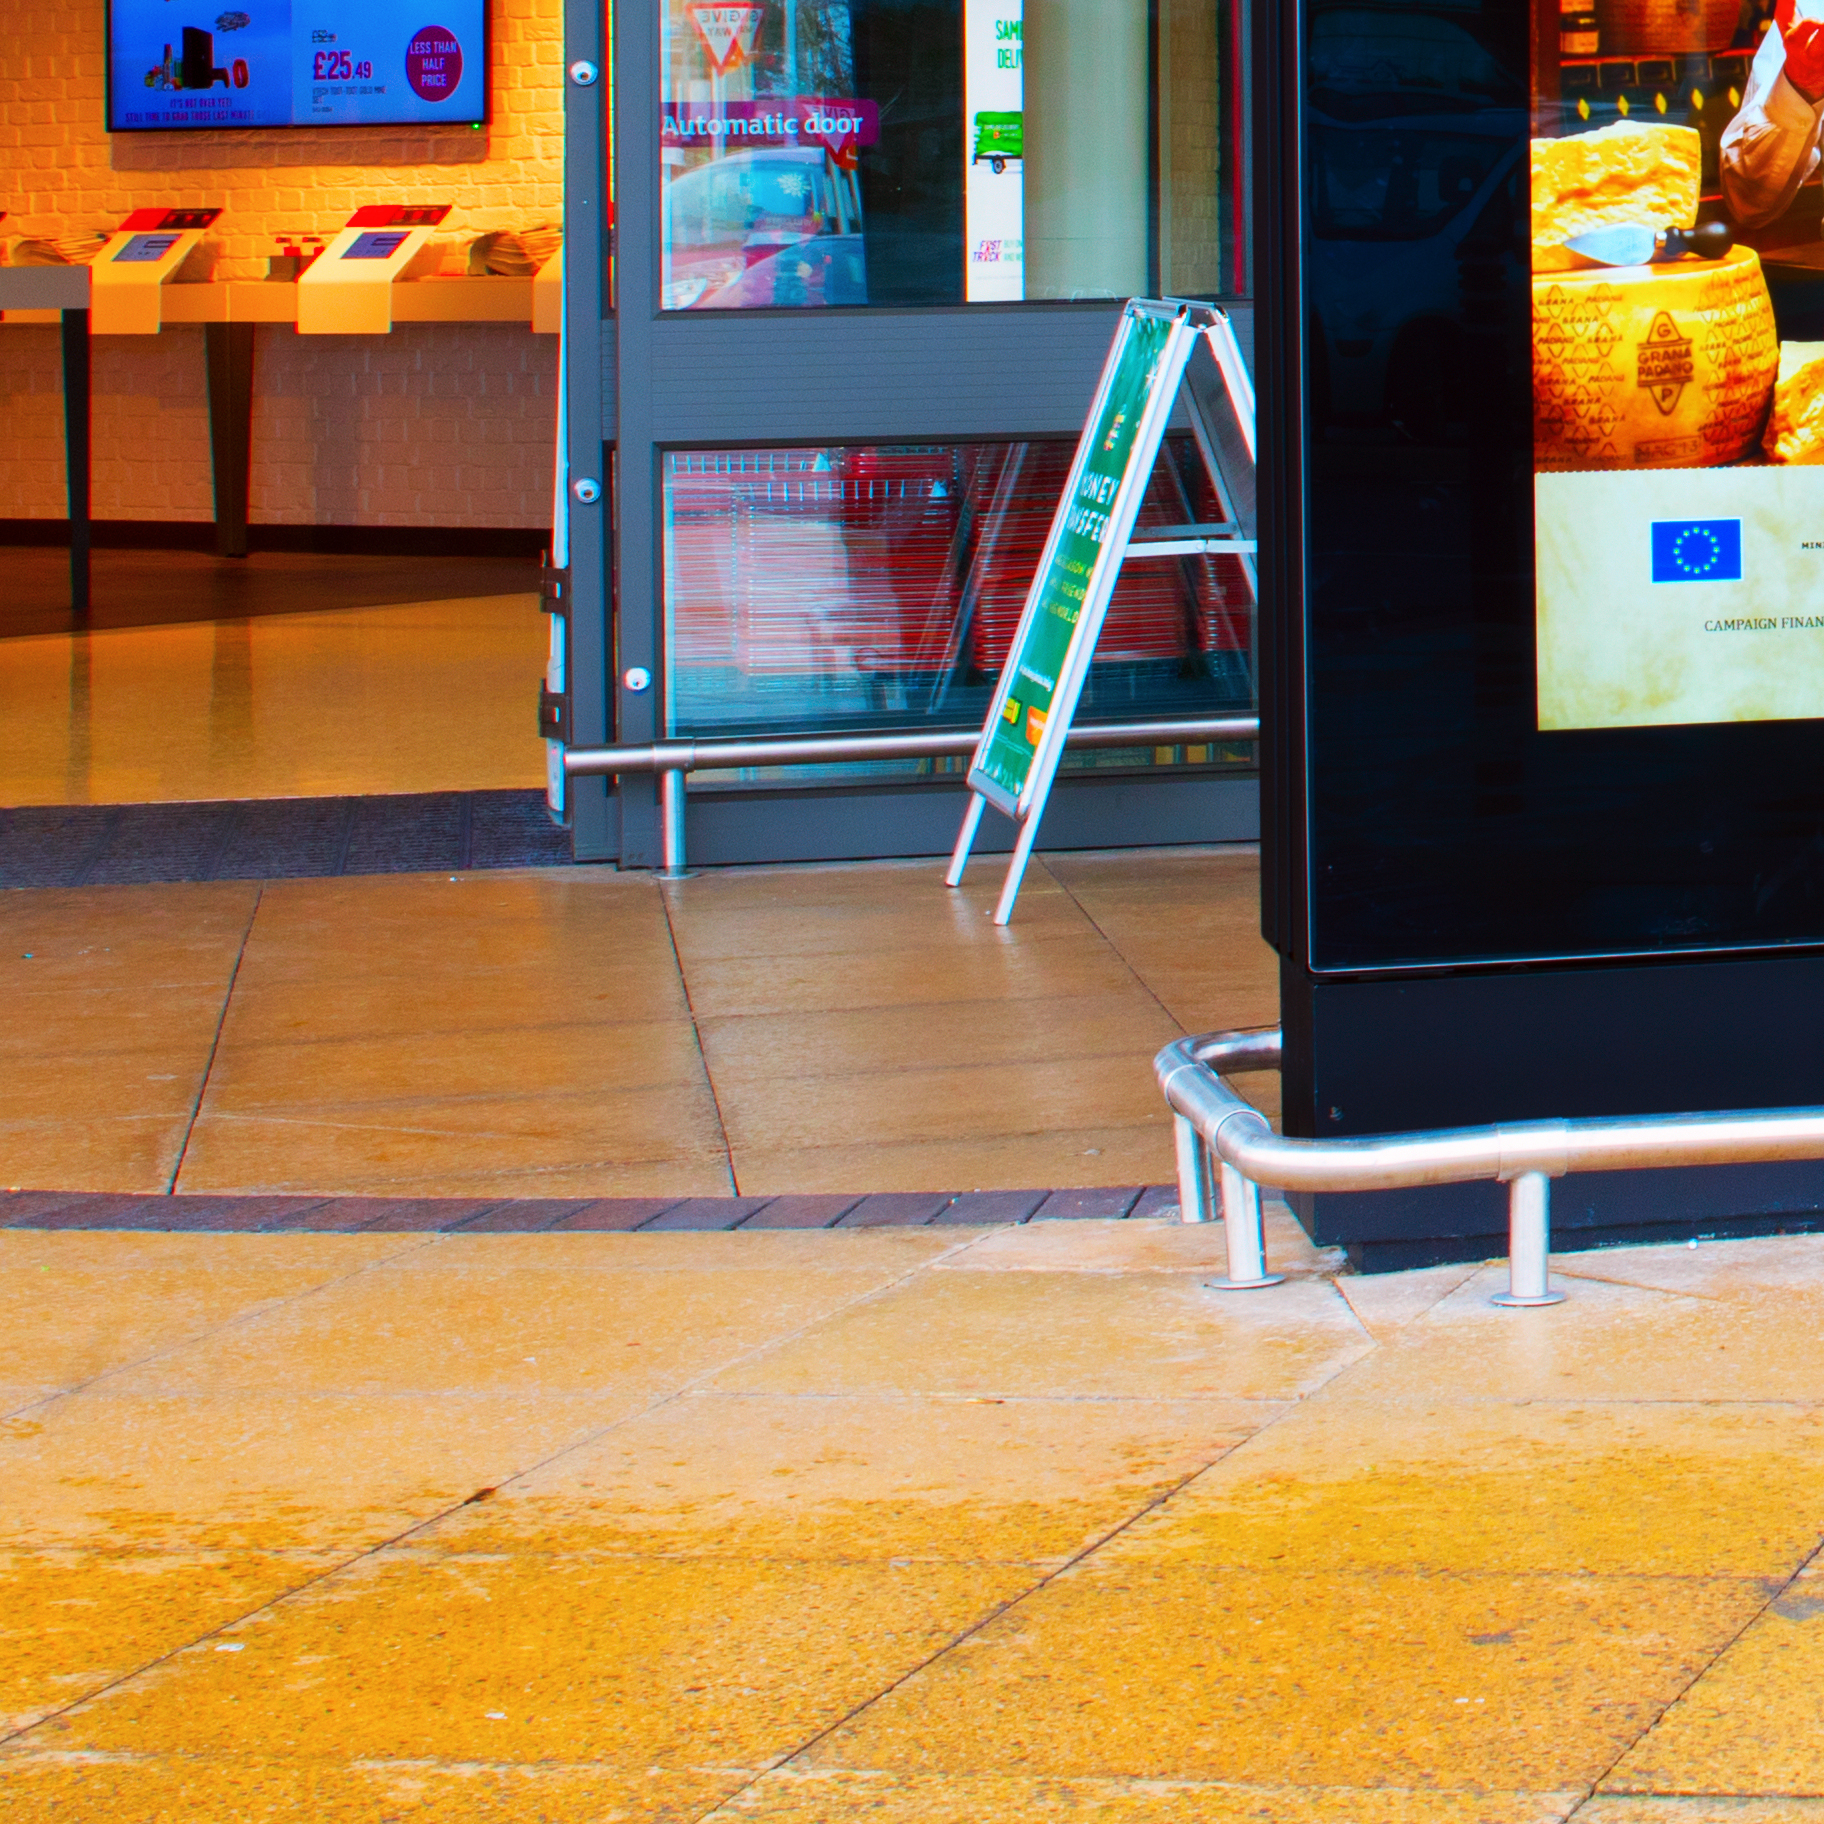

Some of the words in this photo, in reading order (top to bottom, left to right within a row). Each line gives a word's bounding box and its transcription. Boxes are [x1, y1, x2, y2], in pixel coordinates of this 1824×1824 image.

[409, 41, 431, 54] LESS
[433, 41, 458, 53] THAN
[313, 49, 373, 80] £25.49
[422, 57, 445, 71] HALF
[421, 73, 447, 87] PRICE
[661, 112, 798, 135] Automatic
[805, 112, 863, 134] door
[1657, 323, 1671, 338] G
[1638, 346, 1692, 364] GRANA
[1637, 361, 1693, 377] PADANO
[1661, 388, 1673, 402] P
[1704, 617, 1777, 632] CAMPAIGN
